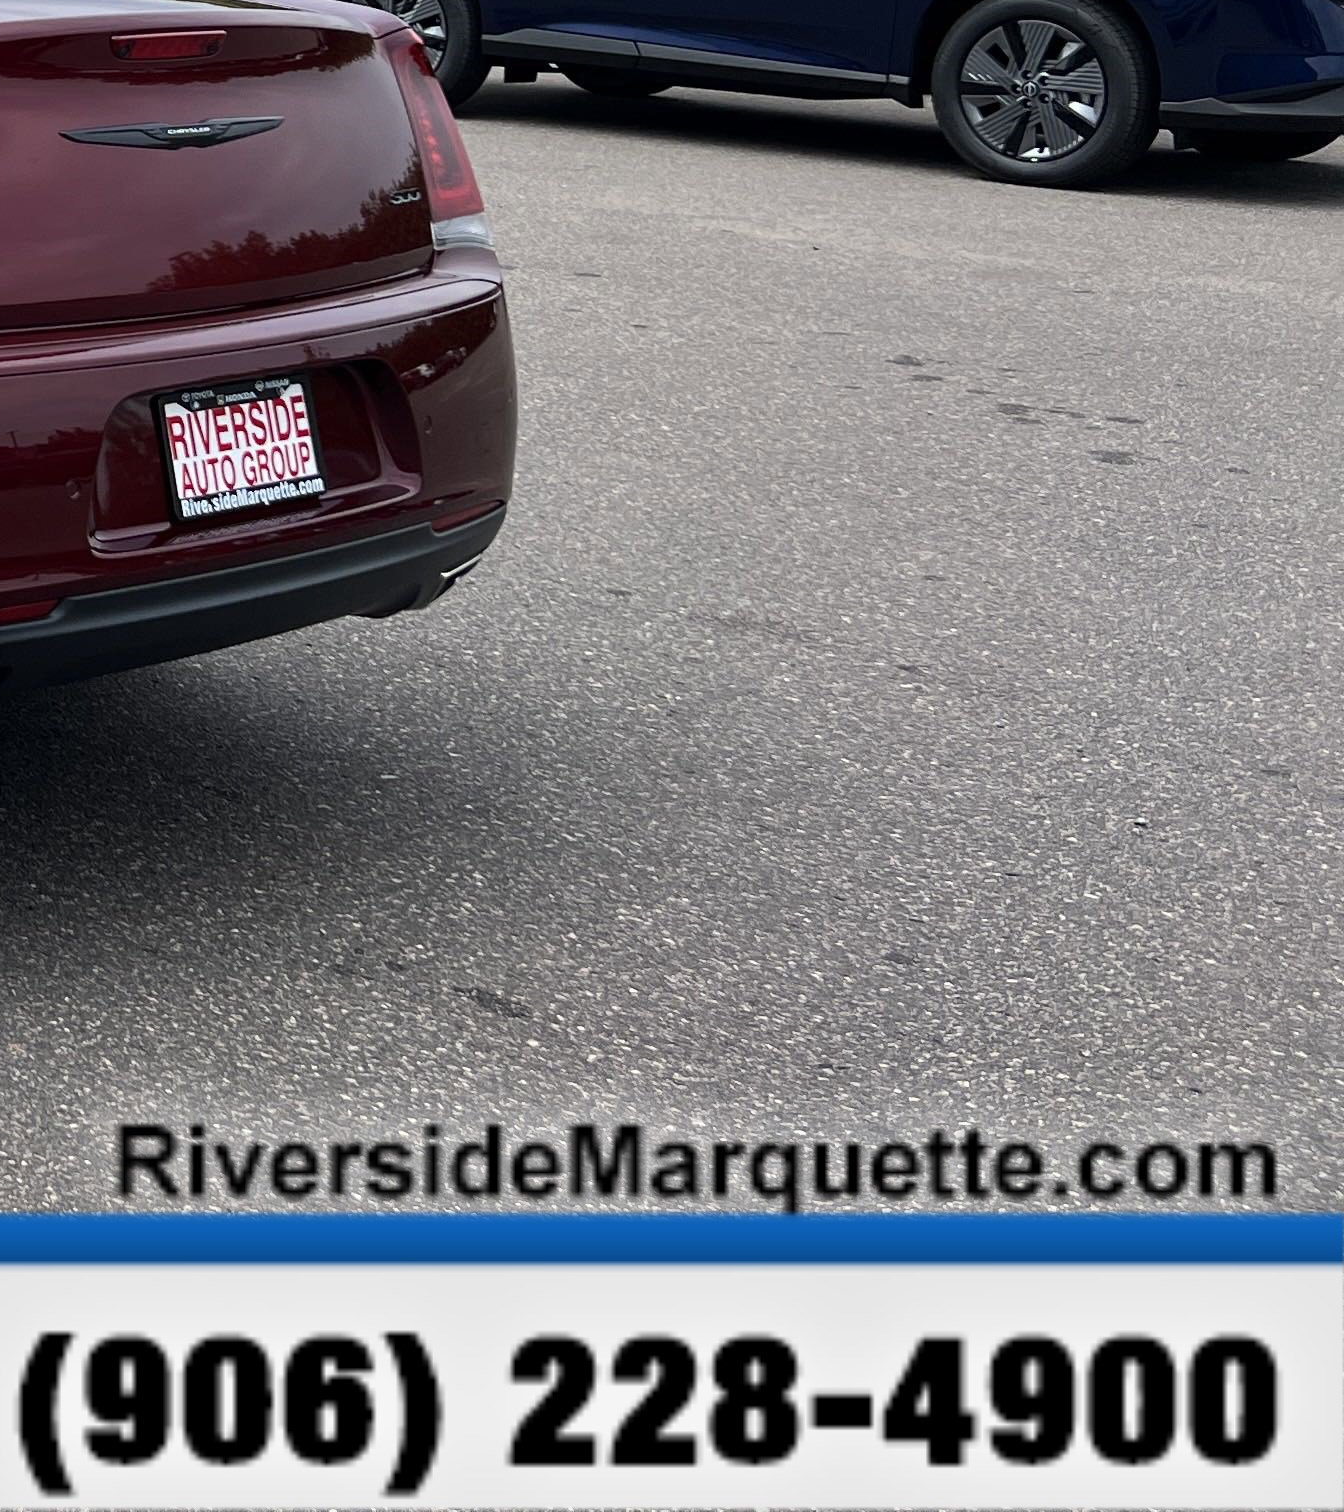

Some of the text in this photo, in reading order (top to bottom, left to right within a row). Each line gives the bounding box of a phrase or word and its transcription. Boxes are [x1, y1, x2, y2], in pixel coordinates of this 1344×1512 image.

[167, 127, 211, 135] CHRYSLER
[191, 389, 215, 400] TOYOTA
[225, 391, 257, 403] HONDA
[167, 395, 311, 460] RIVERSIDE
[182, 441, 310, 498] AUTO GROUP
